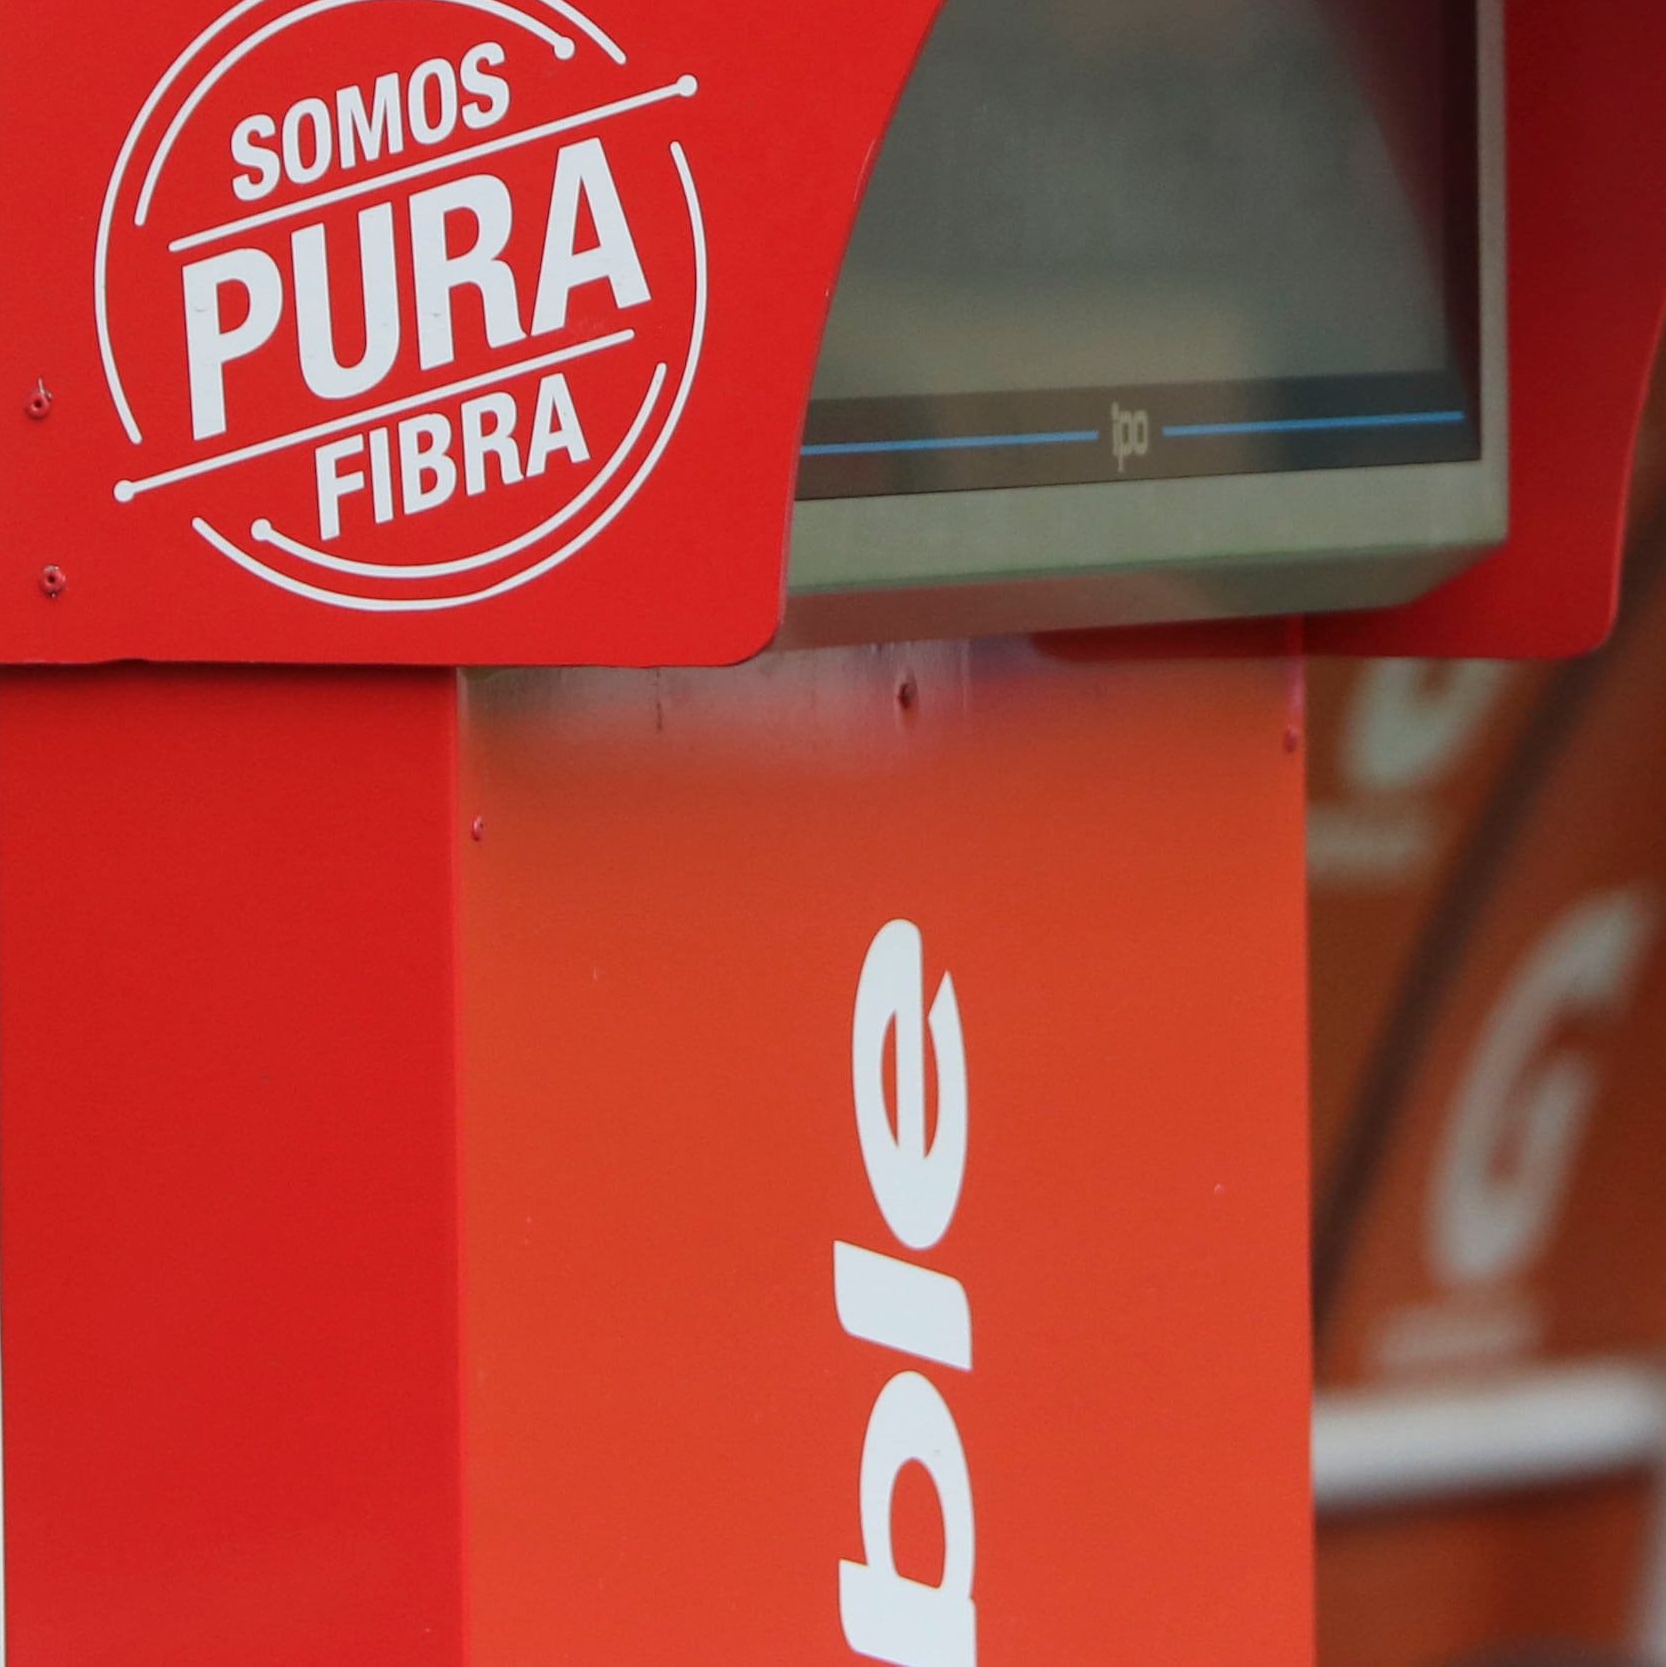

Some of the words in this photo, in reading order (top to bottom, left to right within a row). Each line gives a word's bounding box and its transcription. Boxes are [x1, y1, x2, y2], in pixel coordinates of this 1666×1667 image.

[229, 40, 511, 202] SOMOS
[181, 136, 653, 442] PURA
[312, 372, 592, 542] FIBRA
